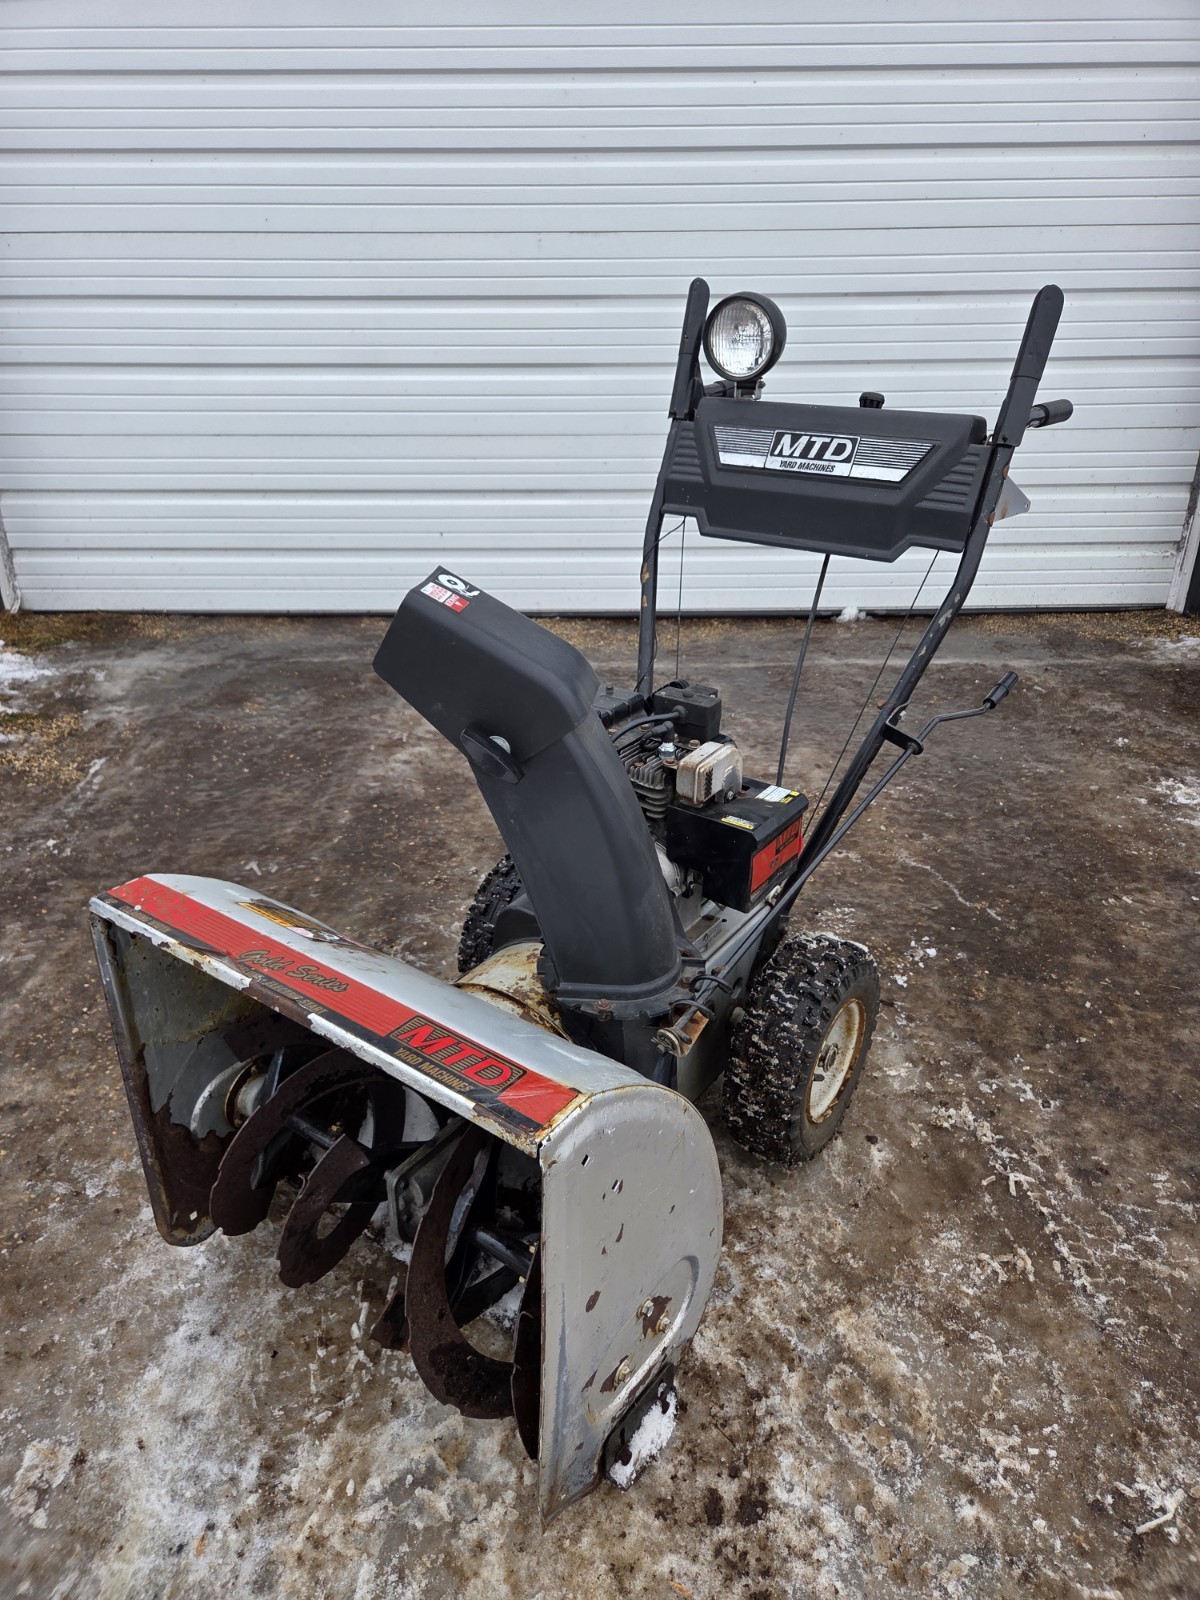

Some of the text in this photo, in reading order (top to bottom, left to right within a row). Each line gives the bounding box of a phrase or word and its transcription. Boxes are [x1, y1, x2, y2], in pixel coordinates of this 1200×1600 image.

[773, 434, 853, 461] MTD
[780, 460, 835, 473] YARD MACHINES
[238, 949, 294, 972] Gold
[286, 965, 350, 992] Series
[300, 998, 328, 1014] START
[394, 1048, 473, 1092] YARD MACHINES
[398, 1024, 512, 1086] MTD
